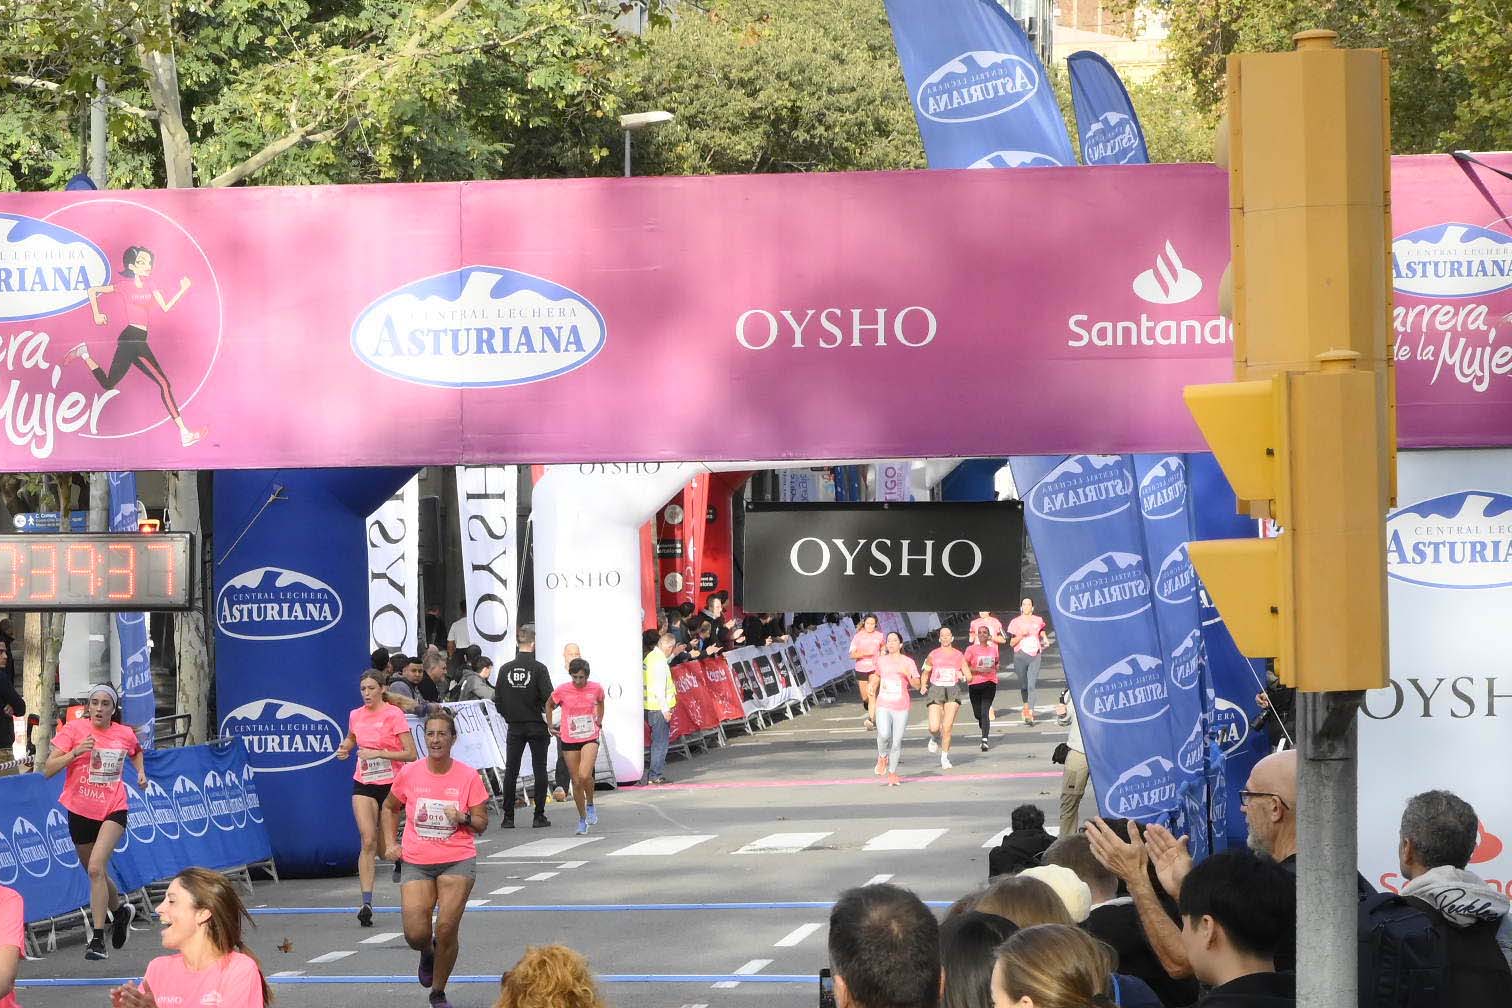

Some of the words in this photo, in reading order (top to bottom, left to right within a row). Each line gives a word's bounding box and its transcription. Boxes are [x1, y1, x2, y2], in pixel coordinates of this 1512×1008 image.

[13, 248, 86, 261] LECHERA
[407, 308, 489, 320] CENTRAL
[497, 307, 578, 318] LECHERA
[1393, 303, 1488, 332] arrera
[372, 312, 586, 357] ASTURIANA
[735, 306, 938, 351] OYSHO
[1068, 314, 1233, 348] Santand
[1417, 335, 1435, 361] la
[1431, 328, 1512, 392] Muje
[1414, 526, 1482, 536] CENTRAL
[790, 536, 983, 578] OYSHO
[1386, 528, 1512, 566] ASTURI
[546, 569, 622, 590] OYSHO
[233, 592, 275, 600] CENTRAL
[280, 591, 329, 600] LECHERA
[220, 597, 333, 625] ASTURIANA
[1361, 677, 1512, 720] OYSH
[235, 724, 275, 733] CENTRAL
[280, 723, 329, 732] LECHERA
[243, 734, 334, 754] TURIANA
[79, 786, 106, 800] SUMA
